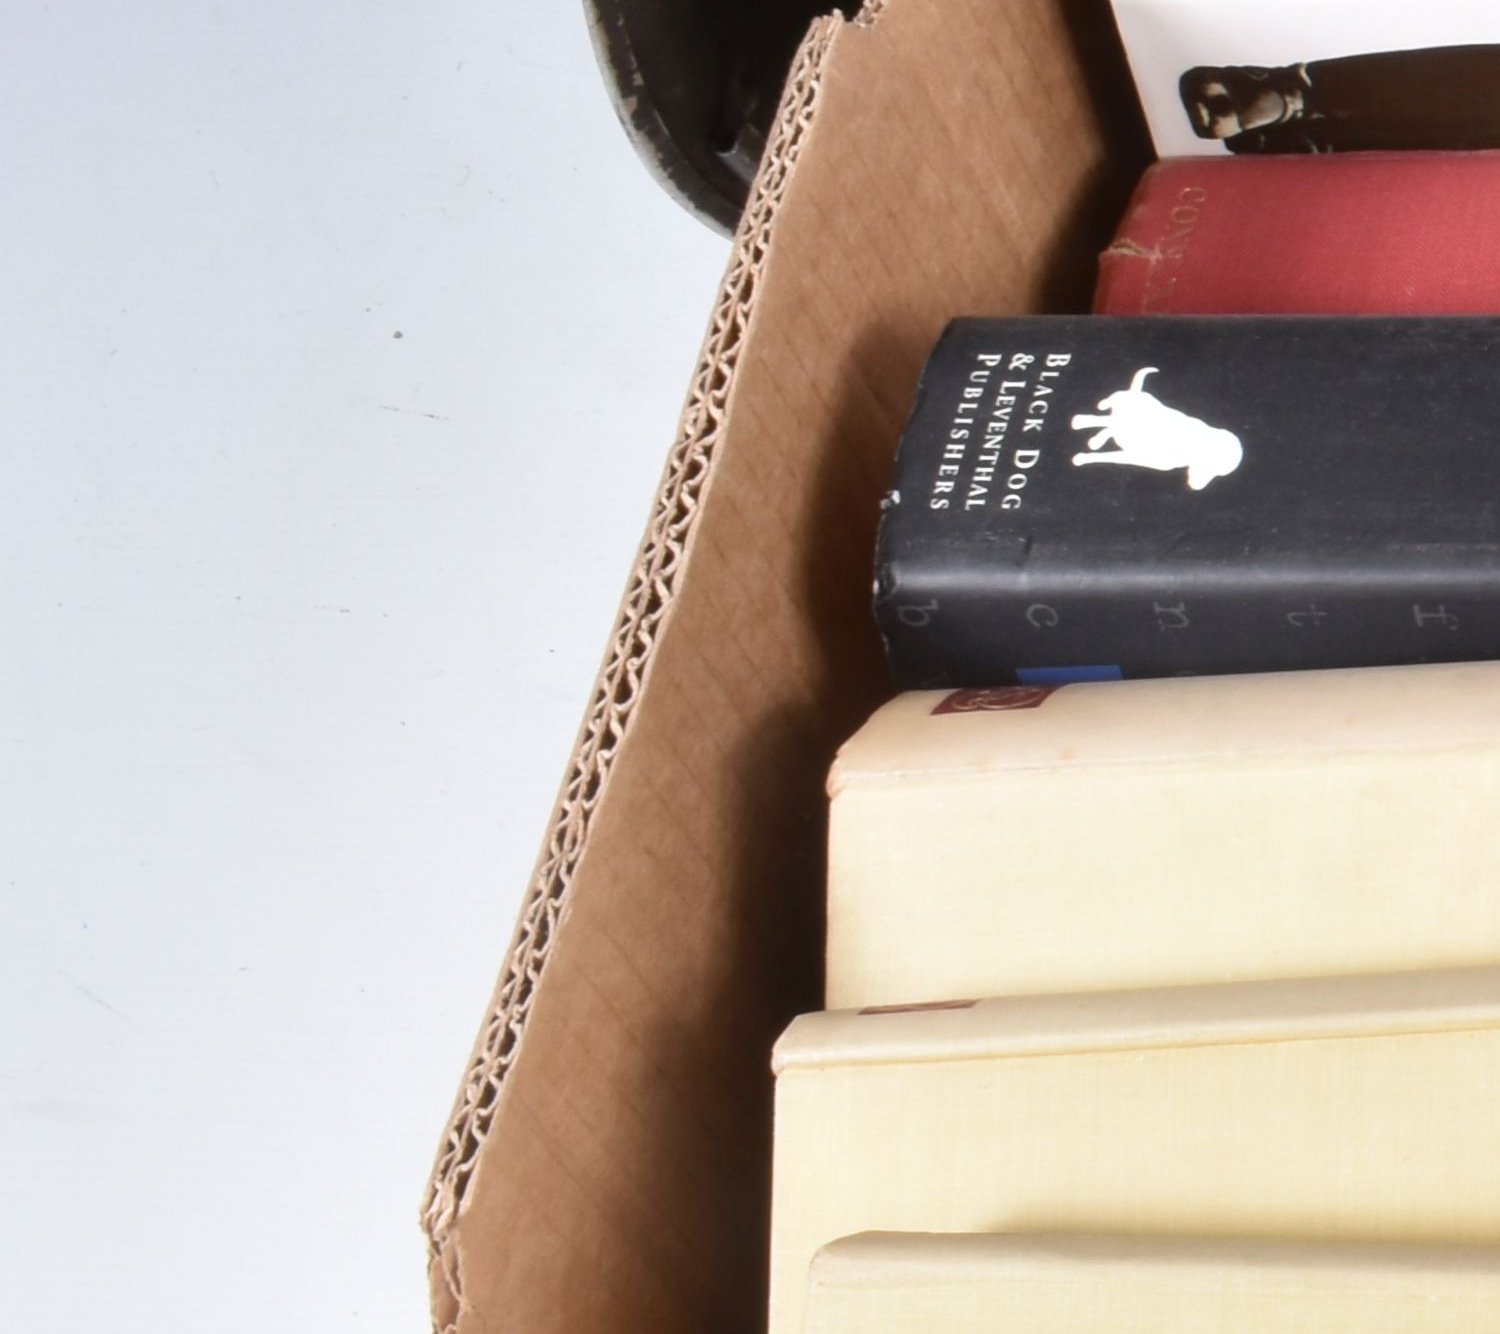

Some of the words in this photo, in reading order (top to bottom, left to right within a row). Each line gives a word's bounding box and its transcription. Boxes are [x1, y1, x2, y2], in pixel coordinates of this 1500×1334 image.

[1008, 352, 1036, 372] &
[1022, 353, 1073, 433] BLACK
[929, 353, 1003, 511] PUBLISHERS
[964, 380, 1028, 512] LEVENTHAL
[1000, 449, 1042, 511] DOG
